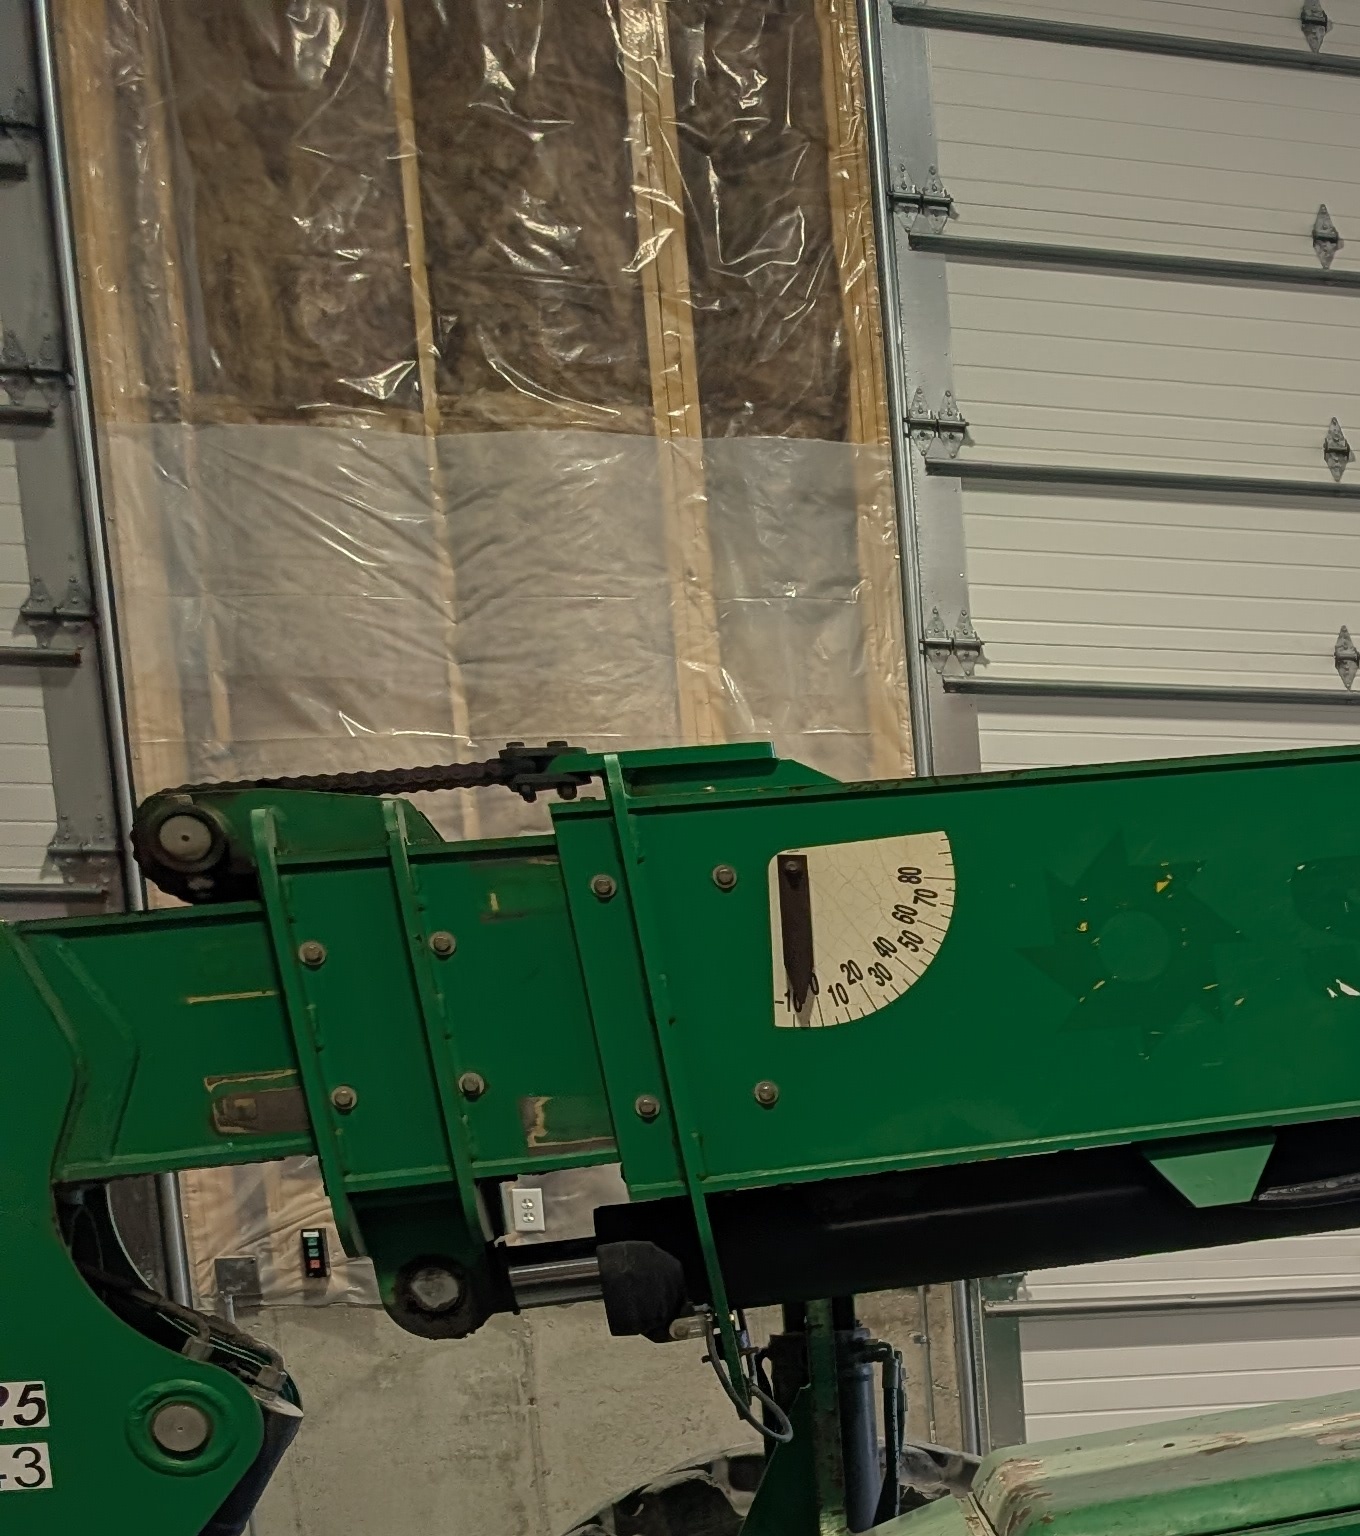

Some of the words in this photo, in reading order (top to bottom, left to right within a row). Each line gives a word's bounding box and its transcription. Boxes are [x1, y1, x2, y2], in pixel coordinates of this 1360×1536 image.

[897, 866, 922, 885] 80
[912, 888, 938, 907] 70
[891, 904, 918, 925] 60
[872, 936, 898, 959] 40
[897, 930, 924, 952] 50
[839, 959, 864, 985] 20
[867, 961, 893, 987] 30
[827, 982, 849, 1007] 10
[0, 1384, 47, 1426] 5
[0, 1446, 46, 1488] 3
